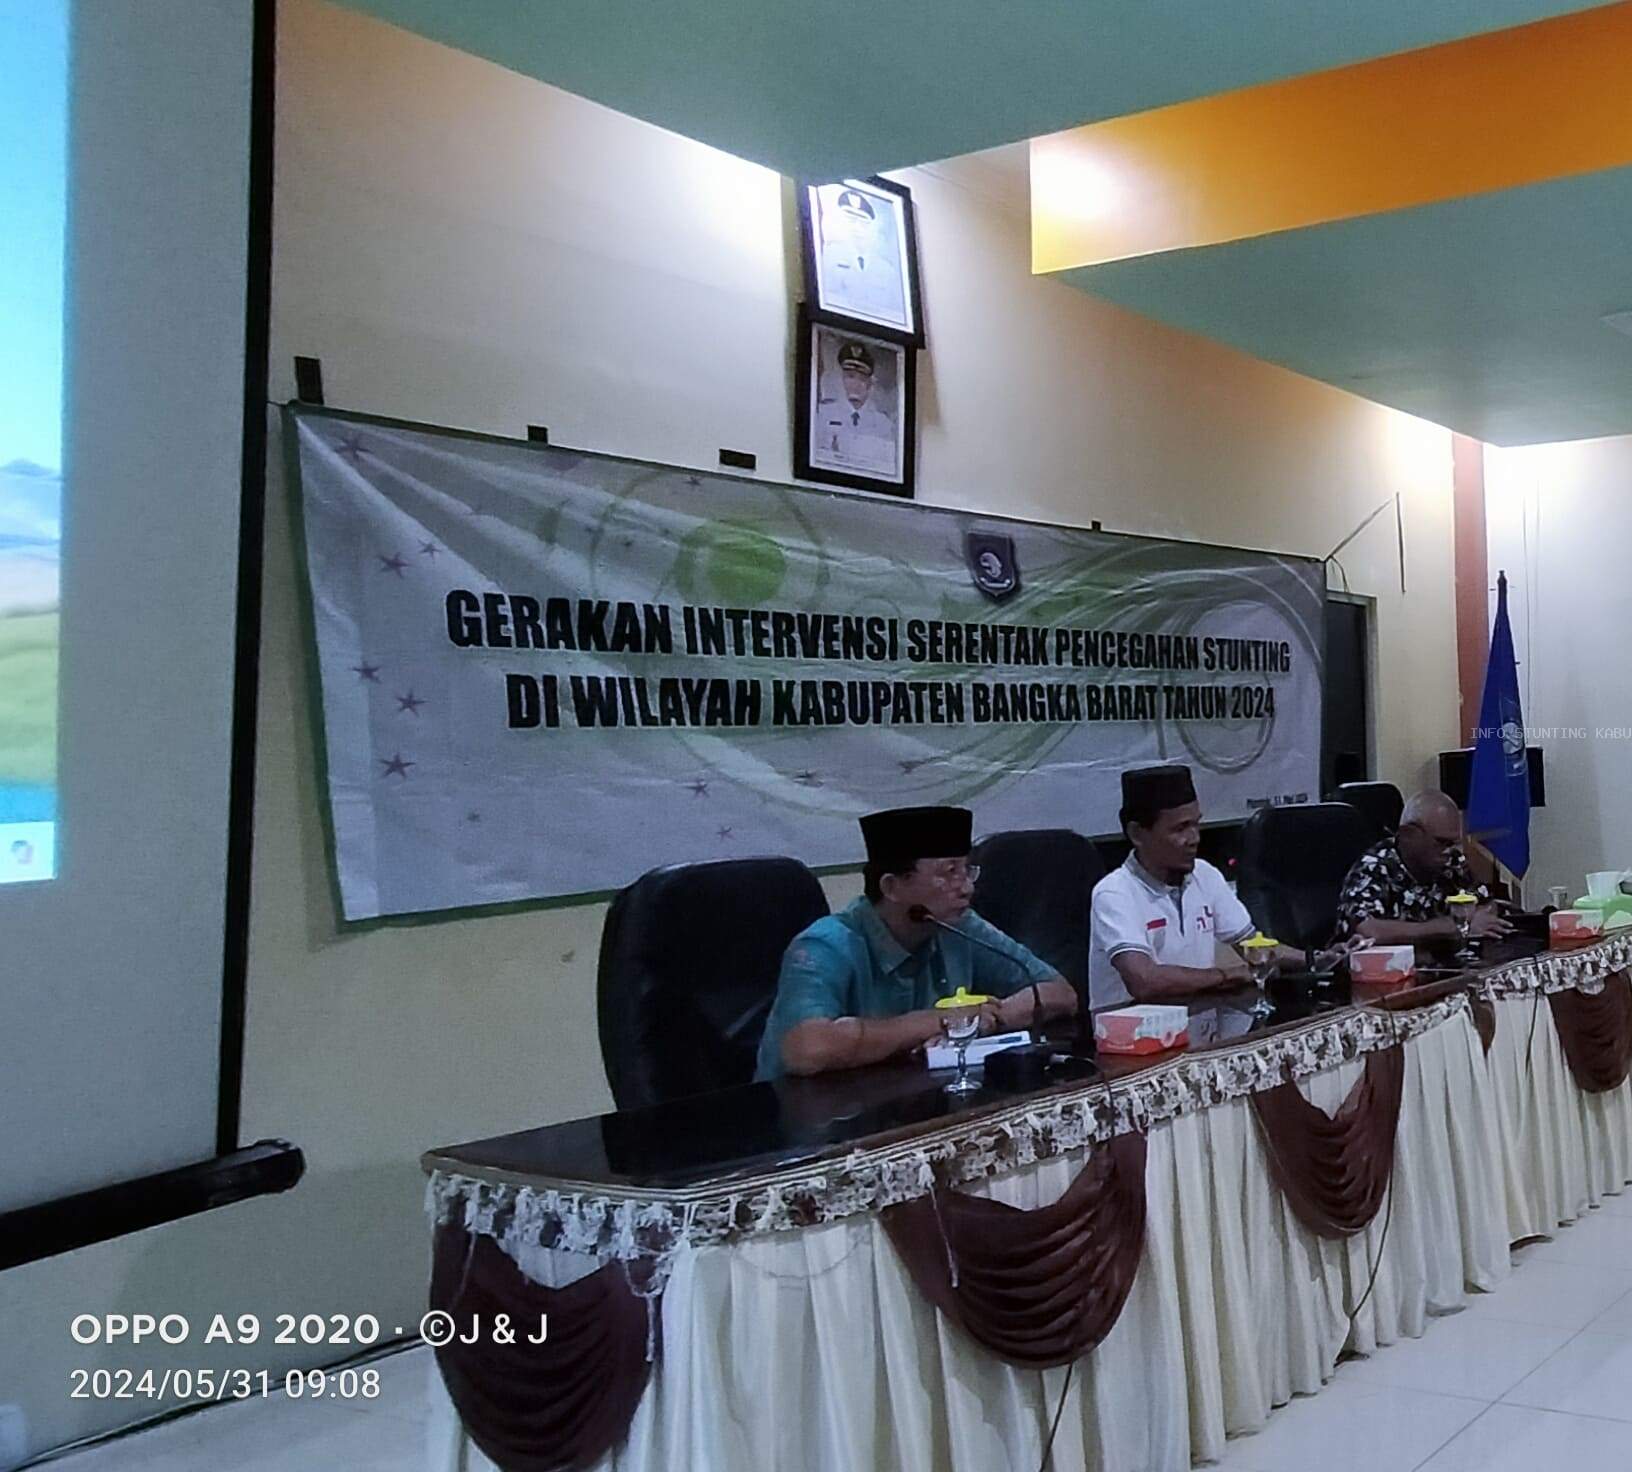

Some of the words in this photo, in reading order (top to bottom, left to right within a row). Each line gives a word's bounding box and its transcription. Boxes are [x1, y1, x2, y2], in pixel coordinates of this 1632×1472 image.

[446, 589, 673, 655] GERAKAN
[683, 606, 898, 661] INTERVENSI
[907, 619, 1049, 666] SERENTAK
[1055, 628, 1199, 670] PENCEGAHAN
[1203, 637, 1291, 673] STUNTING
[506, 673, 560, 728] DI
[570, 675, 761, 728] WILAYAH
[772, 680, 965, 726] KABUPATEN
[972, 682, 1082, 723] BANGKA
[1086, 684, 1158, 721] BARAT
[1163, 685, 1227, 720] TAHUN
[1231, 686, 1276, 719] 2024
